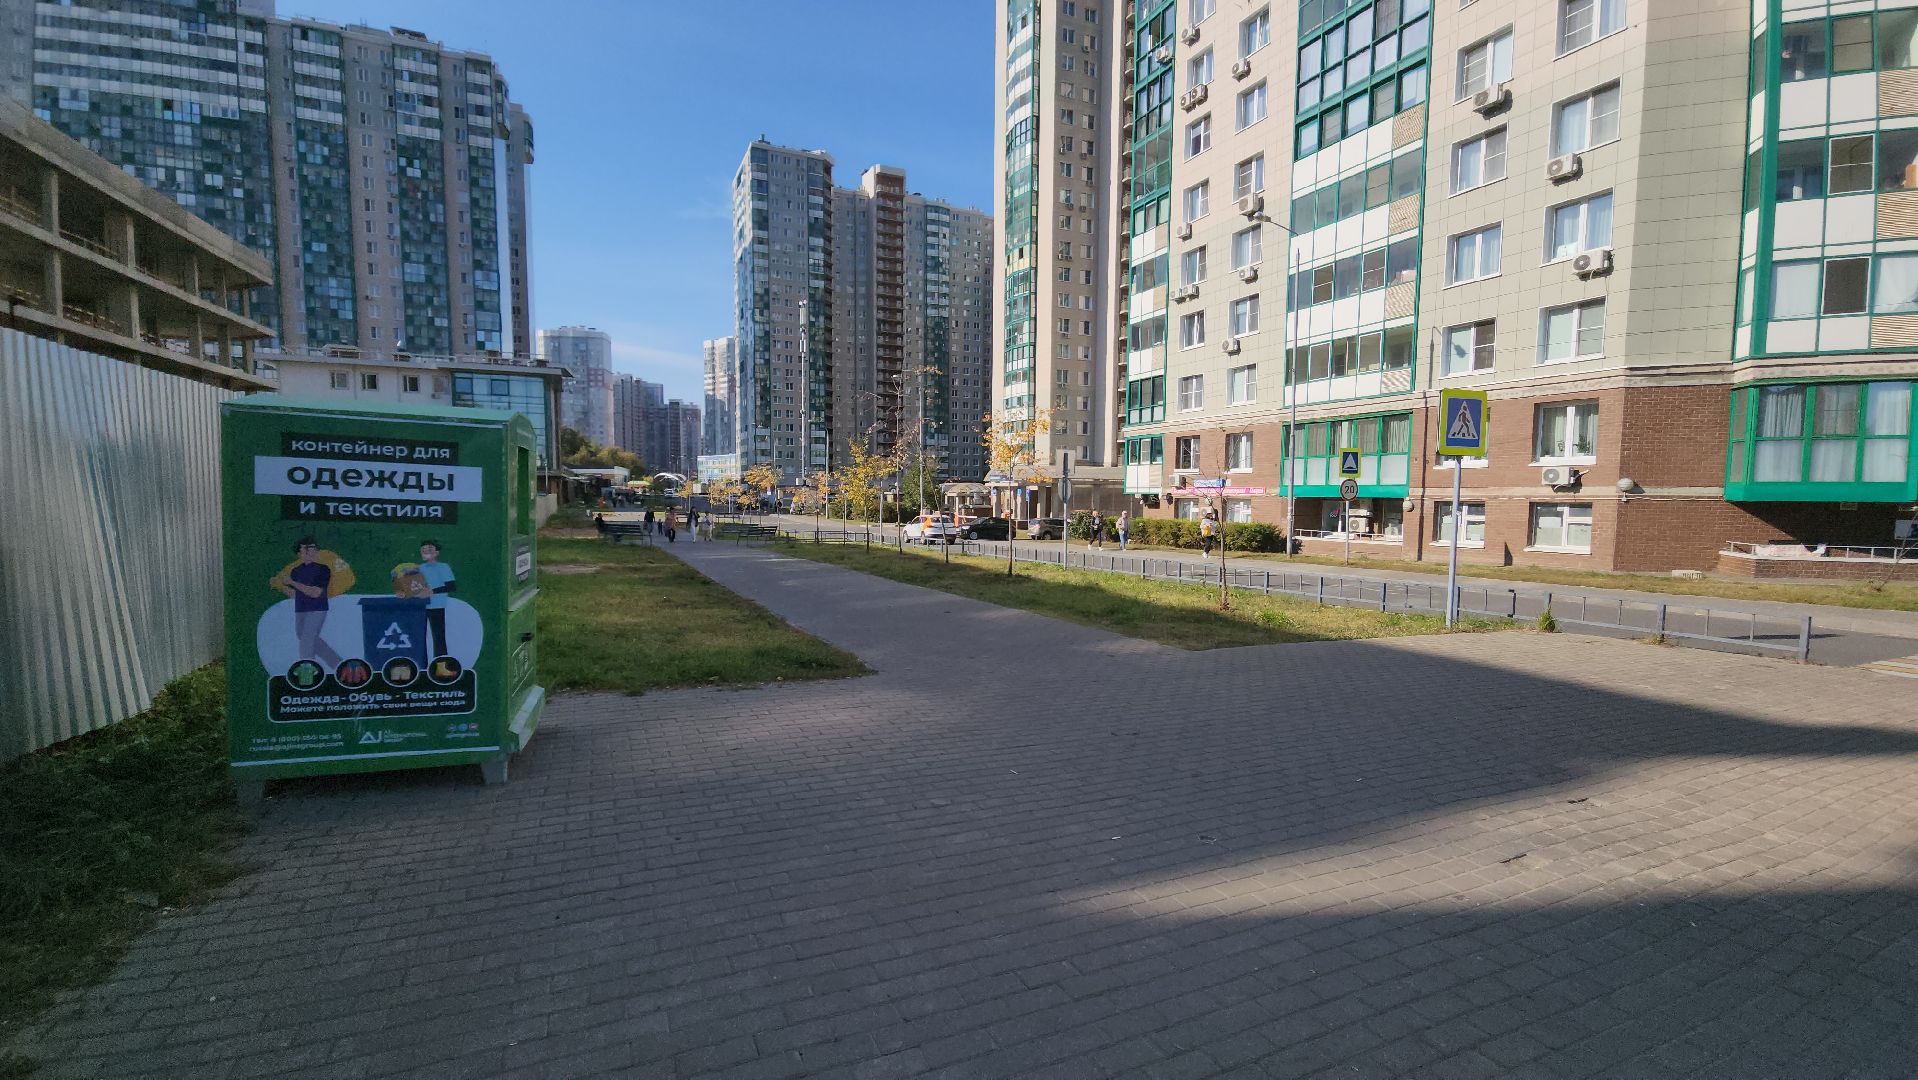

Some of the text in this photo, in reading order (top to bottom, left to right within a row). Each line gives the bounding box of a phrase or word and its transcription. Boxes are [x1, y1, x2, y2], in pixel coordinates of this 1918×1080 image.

[291, 440, 451, 459] контейнер для
[287, 465, 455, 494] одежды
[1344, 485, 1355, 494] 20
[300, 502, 443, 518] и текстиля
[280, 695, 340, 705] Одежда
[348, 691, 392, 703] Обувь
[403, 690, 466, 700] Текстиль
[280, 705, 324, 713] Можете
[326, 703, 380, 712] положить
